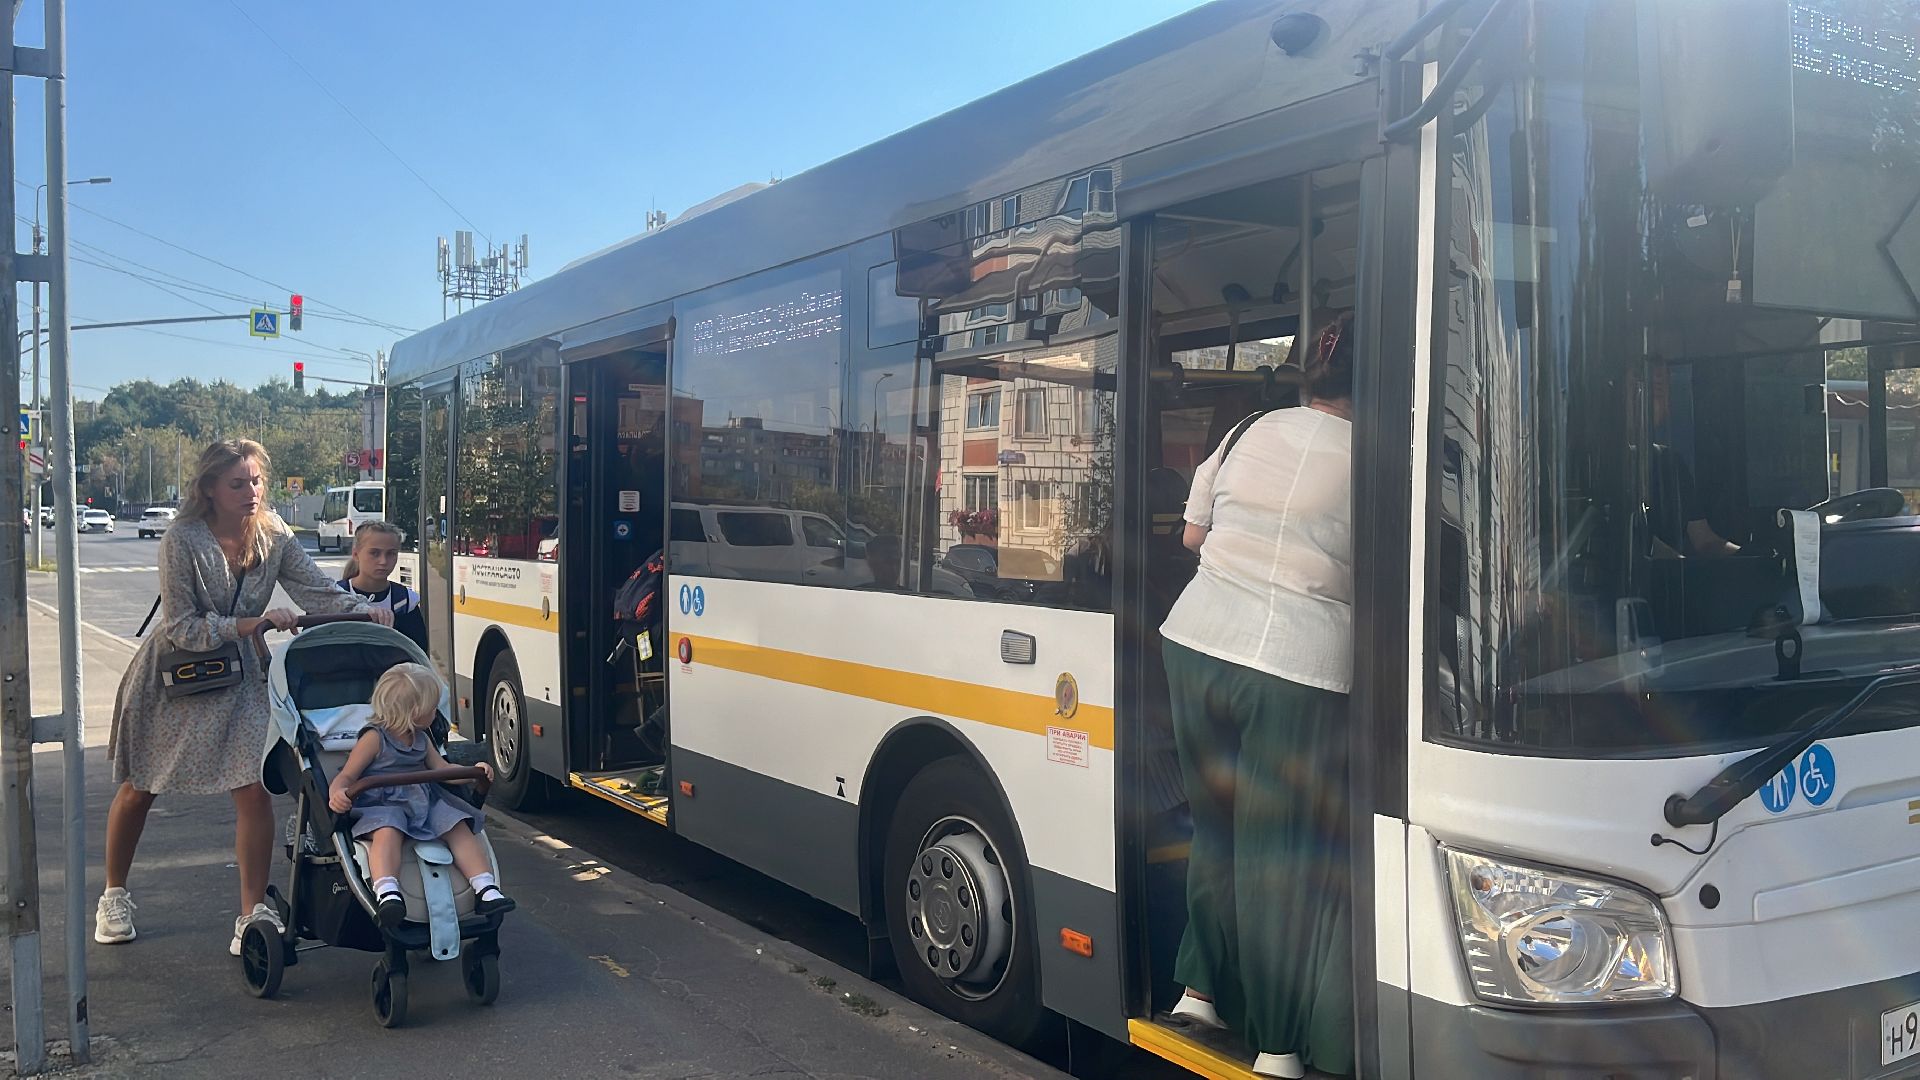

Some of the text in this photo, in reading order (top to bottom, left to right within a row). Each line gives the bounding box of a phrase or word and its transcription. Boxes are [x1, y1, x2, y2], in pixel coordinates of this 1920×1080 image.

[1793, 34, 1920, 91] Щелково-
[1049, 728, 1086, 741] ПРИ АВАРИИ
